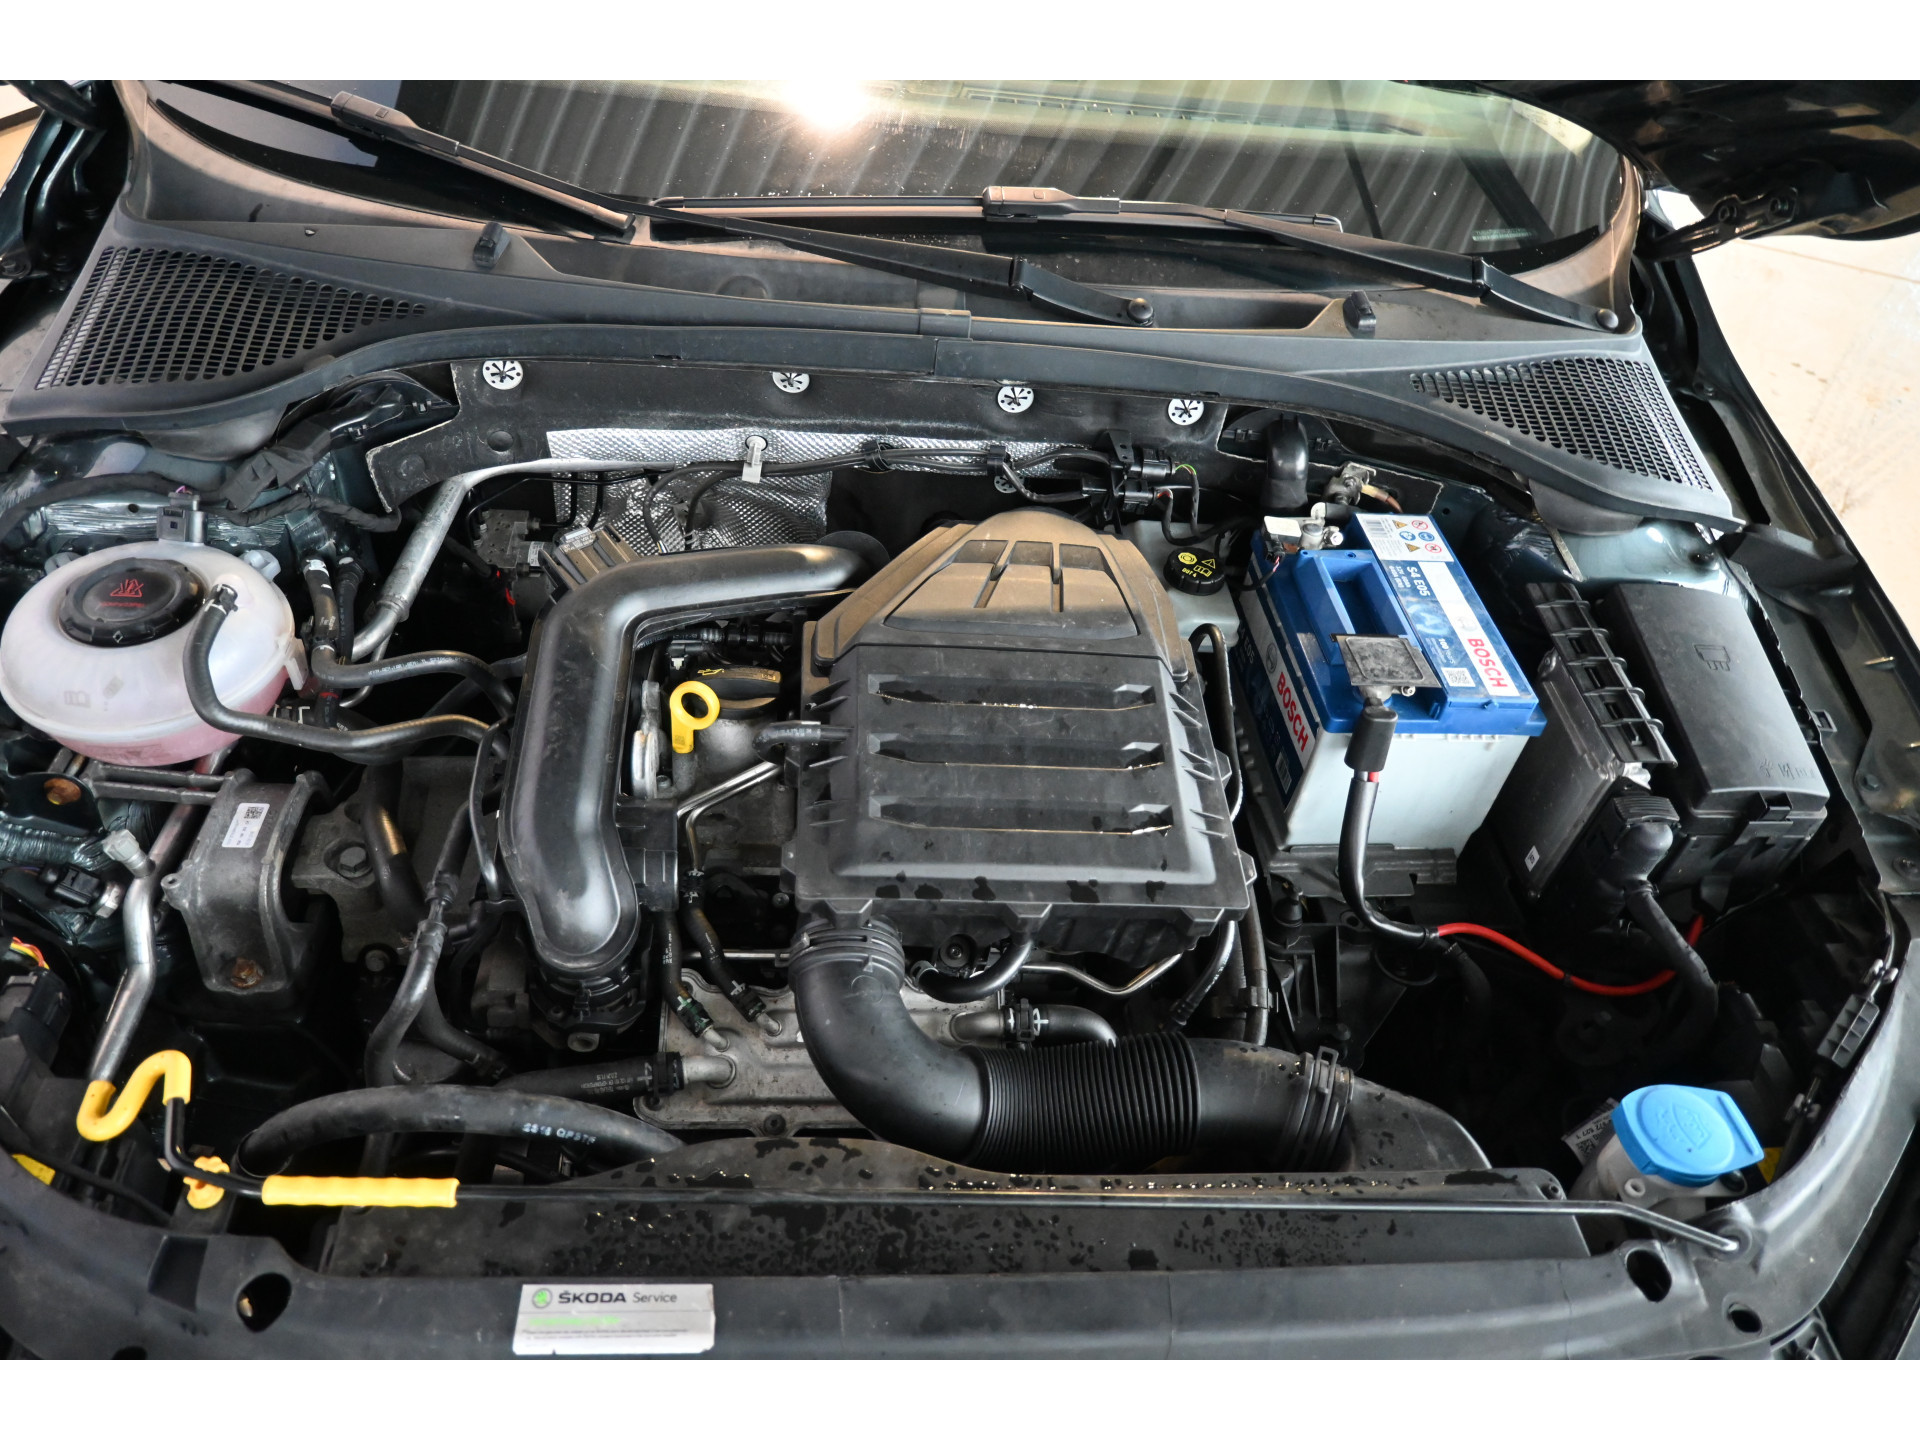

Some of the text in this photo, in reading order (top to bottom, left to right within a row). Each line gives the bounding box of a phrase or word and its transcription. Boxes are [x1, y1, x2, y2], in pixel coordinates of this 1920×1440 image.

[1406, 566, 1431, 597] S4 E05
[1467, 638, 1508, 687] BOSCH
[1277, 672, 1308, 752] BOSCH
[558, 1290, 678, 1304] ŠKODA Service
